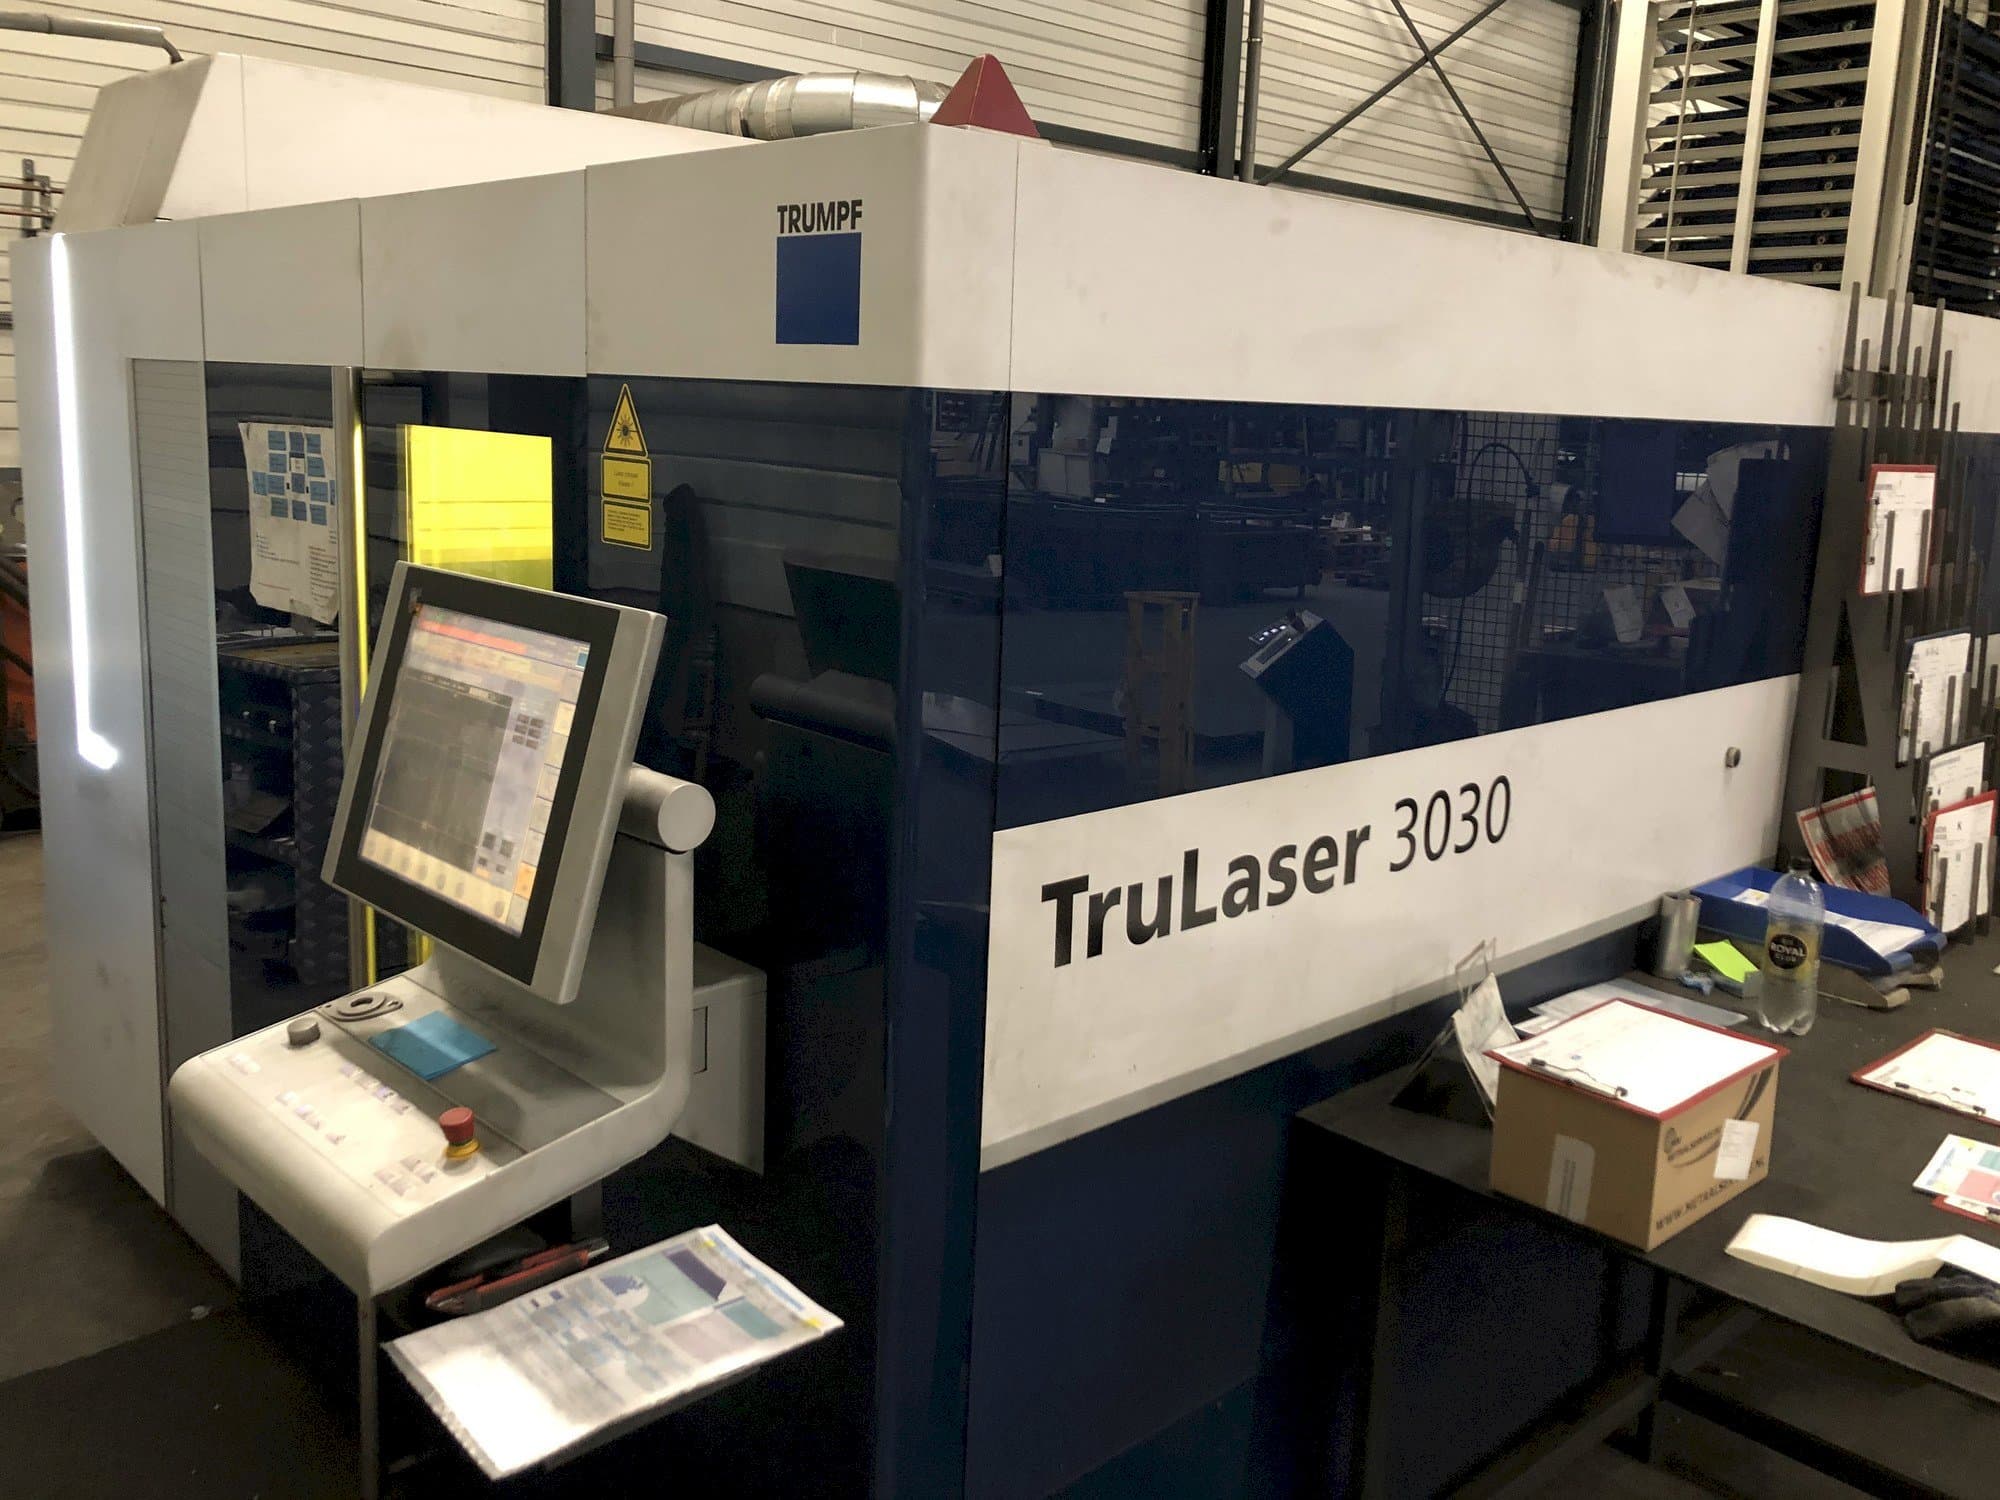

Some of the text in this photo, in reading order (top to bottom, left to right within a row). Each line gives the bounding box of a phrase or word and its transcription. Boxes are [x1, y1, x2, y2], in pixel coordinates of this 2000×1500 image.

[777, 199, 862, 234] TRUMPF
[1041, 774, 1511, 968] TruLaser 3030
[1771, 942, 1805, 957] ROYAL
